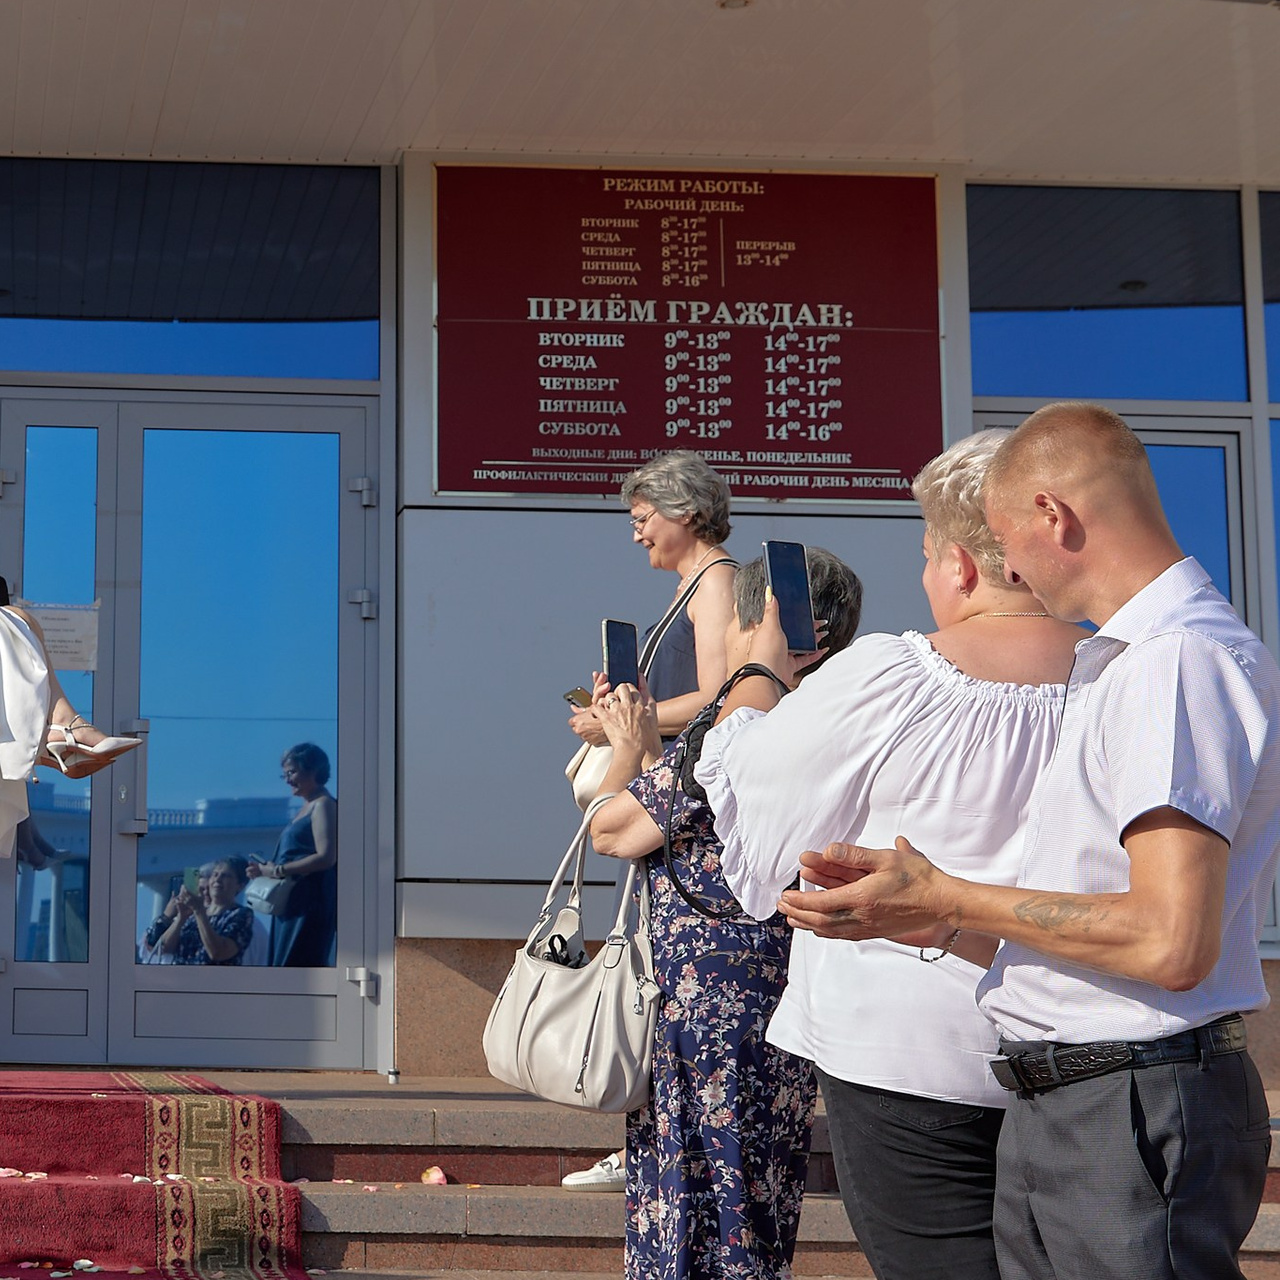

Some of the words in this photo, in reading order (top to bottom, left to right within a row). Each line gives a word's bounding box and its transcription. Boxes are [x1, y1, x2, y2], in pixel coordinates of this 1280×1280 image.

[603, 178, 675, 193] РЕЖИМ
[680, 179, 765, 195] РАБОТЫ:
[625, 198, 697, 211] РАБОЧИЙ
[700, 200, 745, 213] ДЕНЬ:
[581, 218, 639, 228] ВТОРНИК
[581, 232, 621, 243] СРЕДА
[582, 247, 636, 257] ЧЕТВЕРГ
[736, 240, 796, 252] ПЕРЕРЫВ
[582, 261, 641, 272] ПЯТНИЦА
[582, 275, 638, 286] СУББОТА
[526, 293, 658, 323] ПРИЁМ
[666, 300, 854, 332] ГРАЖДАН:
[538, 333, 625, 348] ВТОРНИК
[538, 354, 597, 371] СРЕДА
[539, 376, 619, 391] ЧЕТВЕРГ
[539, 399, 627, 415] ПЯТНИЦА
[539, 422, 621, 437] СУББОТА
[532, 447, 605, 460] ВЫХОДНЫЕ
[607, 449, 637, 460] ДНИ:
[747, 451, 852, 464] ПОНЕДЕЛЬНИК
[811, 476, 850, 488] ДЕНЬ
